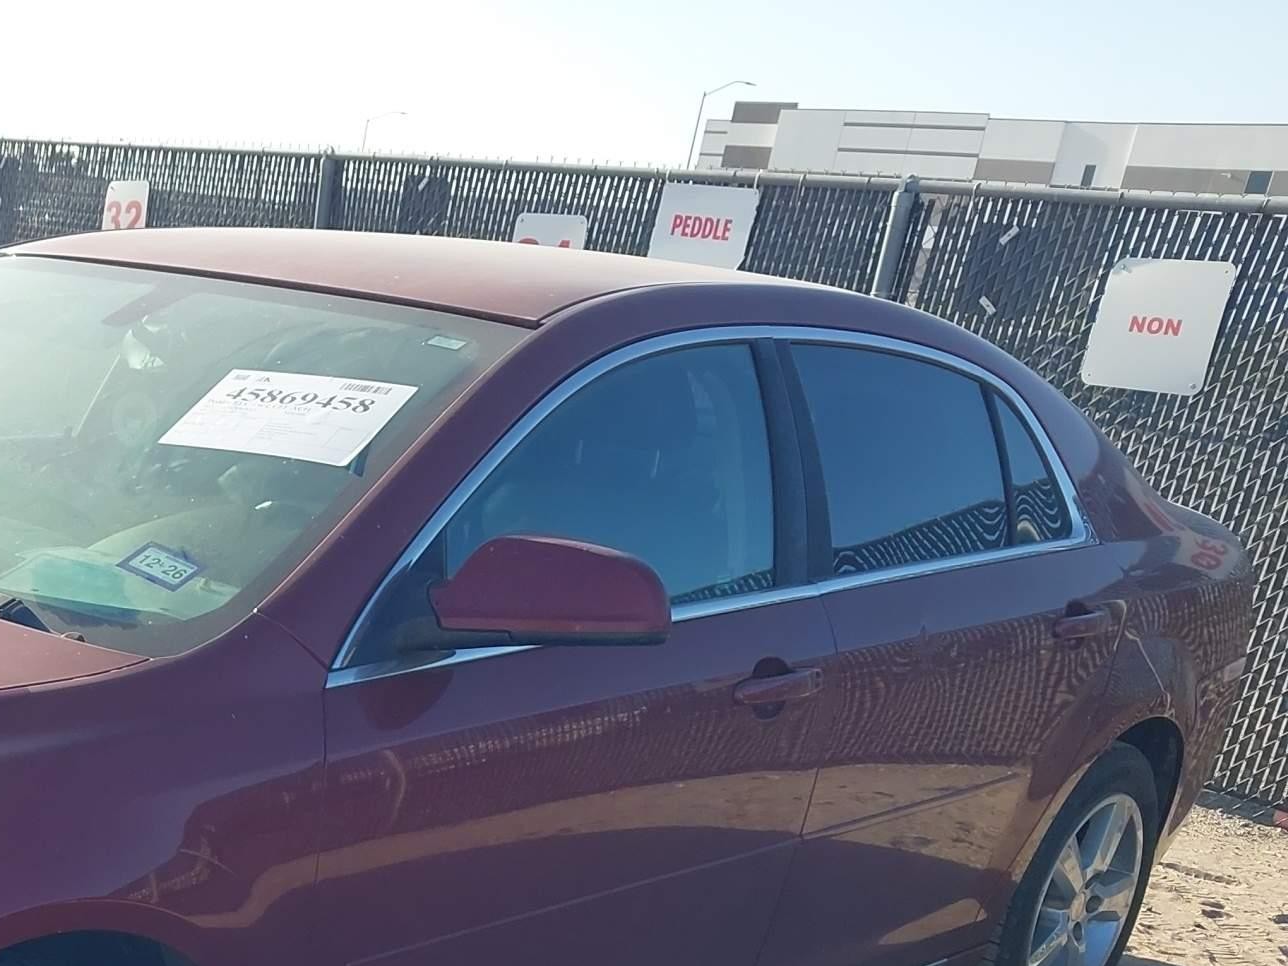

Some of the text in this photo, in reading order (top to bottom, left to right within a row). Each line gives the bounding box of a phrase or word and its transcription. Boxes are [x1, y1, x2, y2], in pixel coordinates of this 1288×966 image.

[106, 200, 142, 229] 32
[670, 214, 733, 241] PEDDLE
[1128, 315, 1183, 337] NON
[225, 386, 376, 414] 45869458
